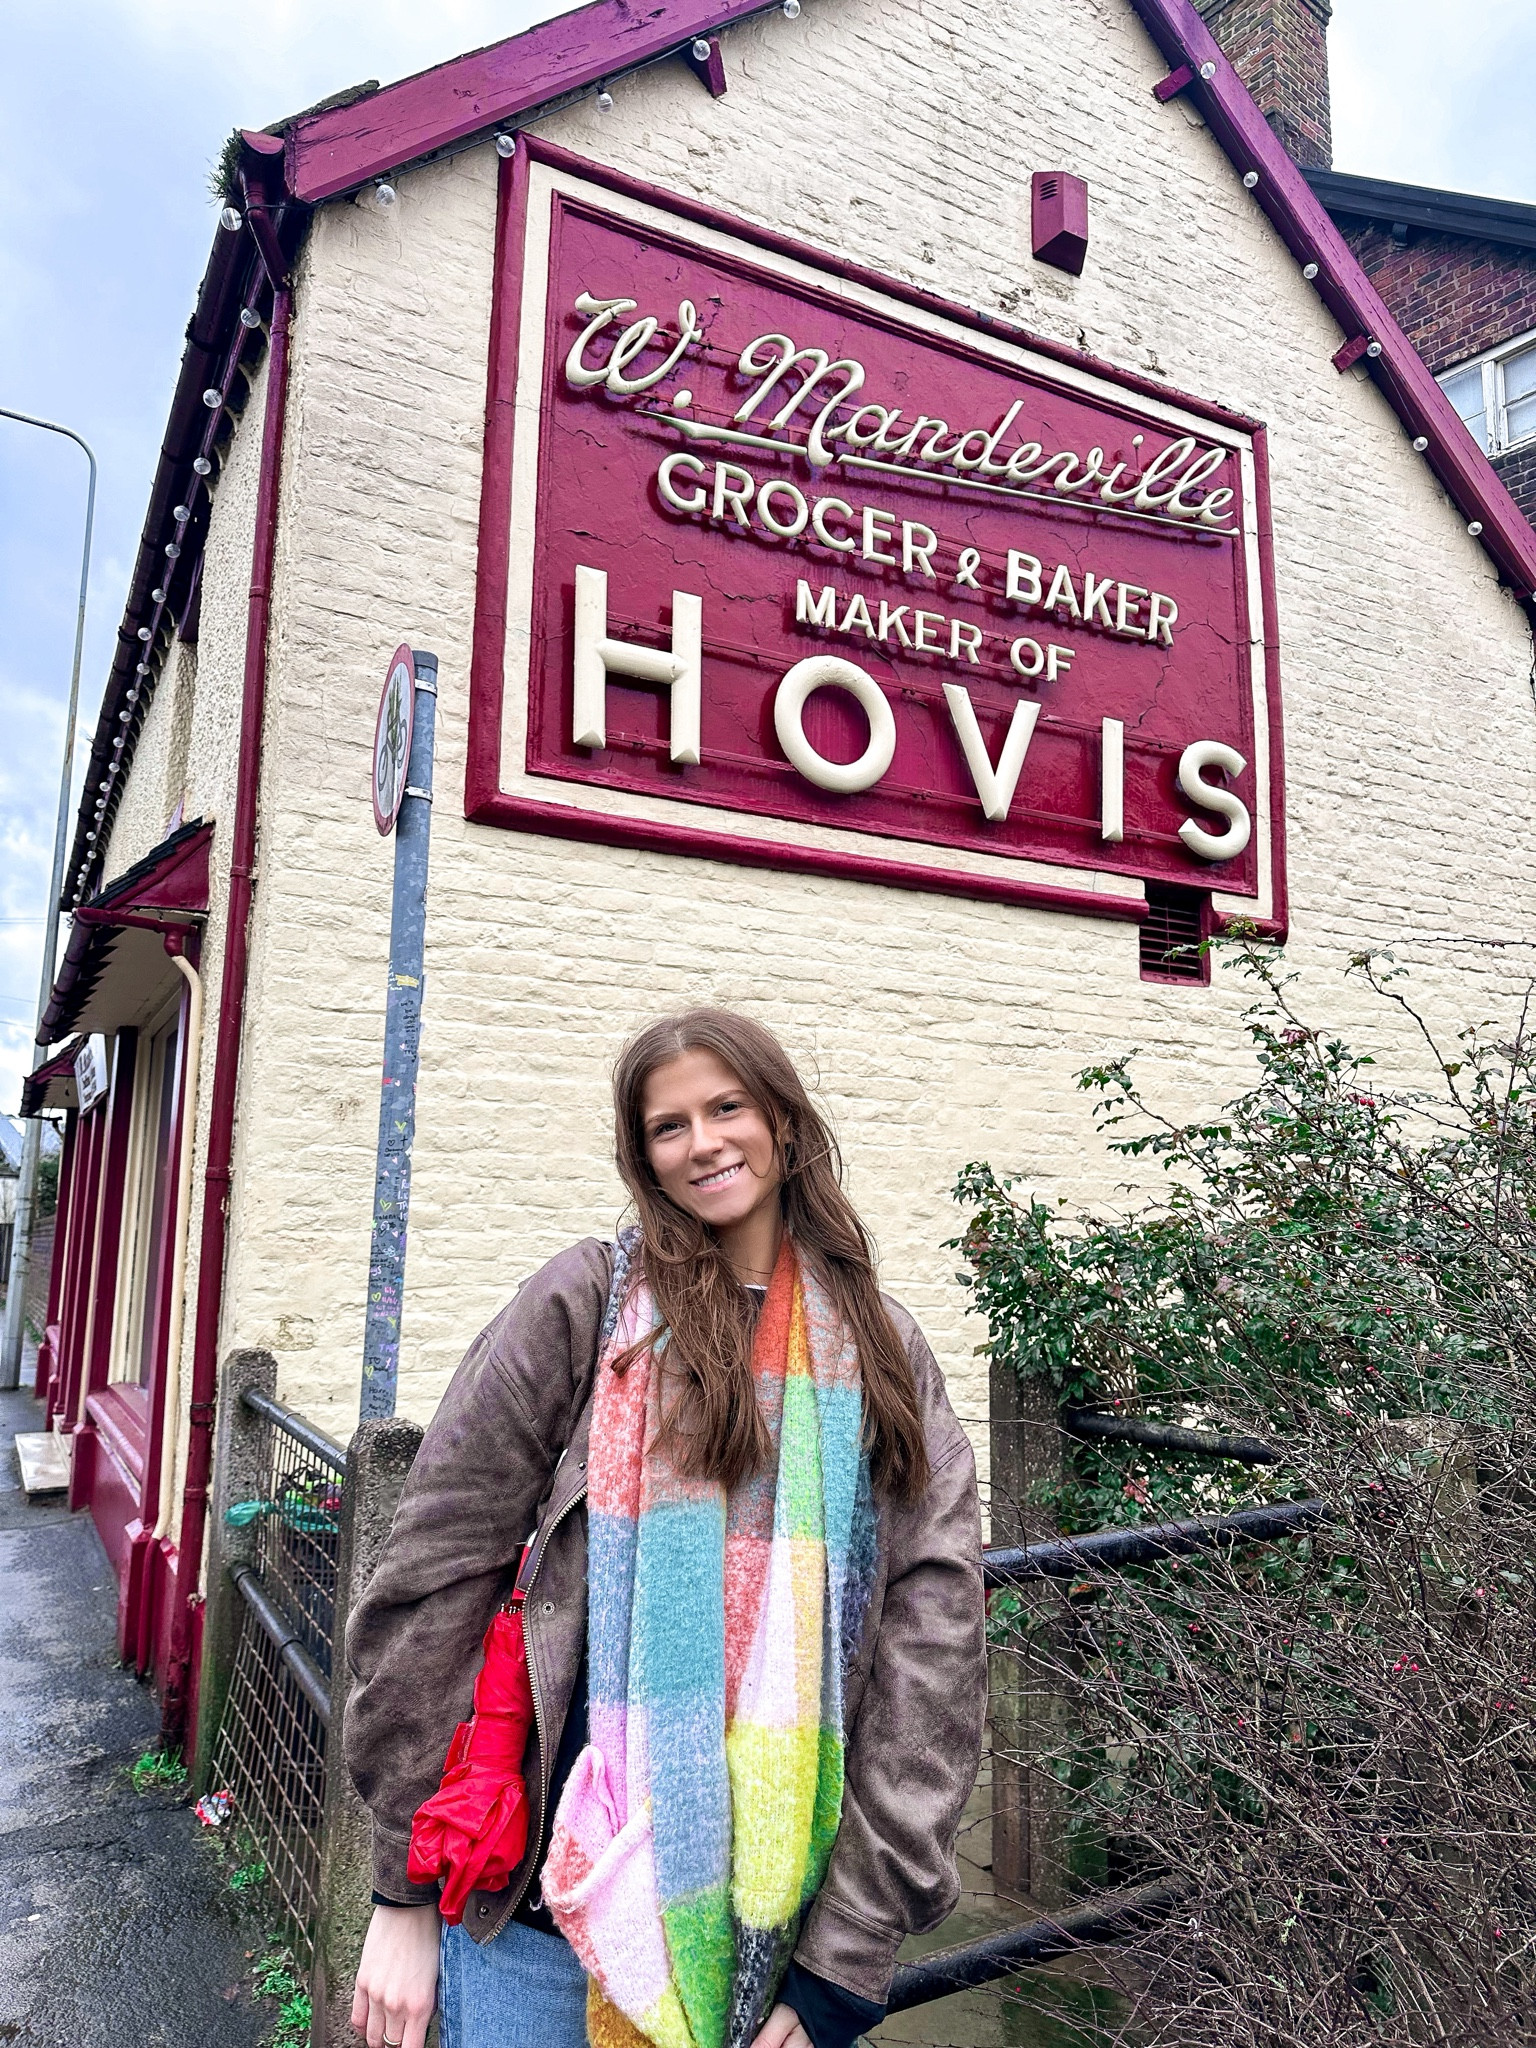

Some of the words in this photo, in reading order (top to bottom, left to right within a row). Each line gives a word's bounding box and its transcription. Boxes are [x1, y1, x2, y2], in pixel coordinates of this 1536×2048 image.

[566, 291, 702, 408] W.
[734, 333, 1235, 525] Mandeville
[657, 452, 939, 580] GROCER
[956, 547, 982, 590] &
[1005, 548, 1179, 647] BAKER
[796, 579, 984, 665] MAKER
[1009, 637, 1076, 684] OF
[573, 564, 1251, 862] HOVIS
